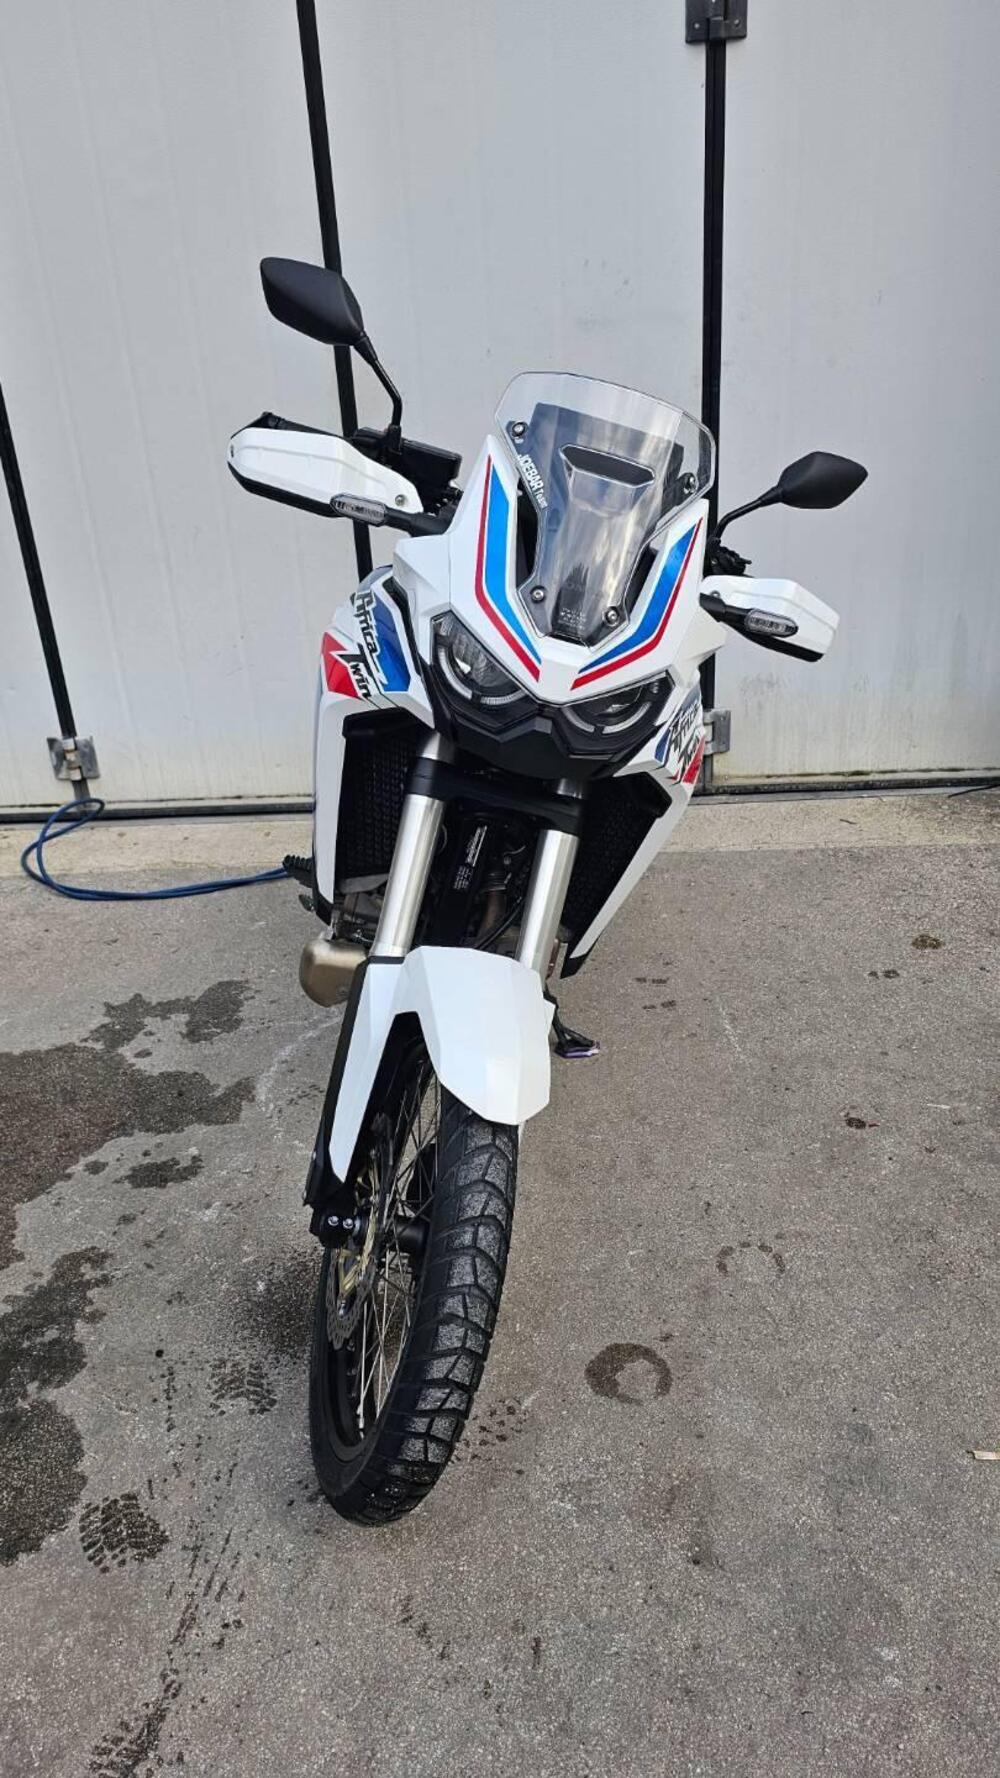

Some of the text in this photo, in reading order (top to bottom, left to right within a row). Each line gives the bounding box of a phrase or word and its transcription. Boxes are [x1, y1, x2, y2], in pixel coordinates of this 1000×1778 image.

[516, 454, 544, 491] JOEBAR
[349, 589, 378, 655] Africa
[336, 642, 381, 698] Twin
